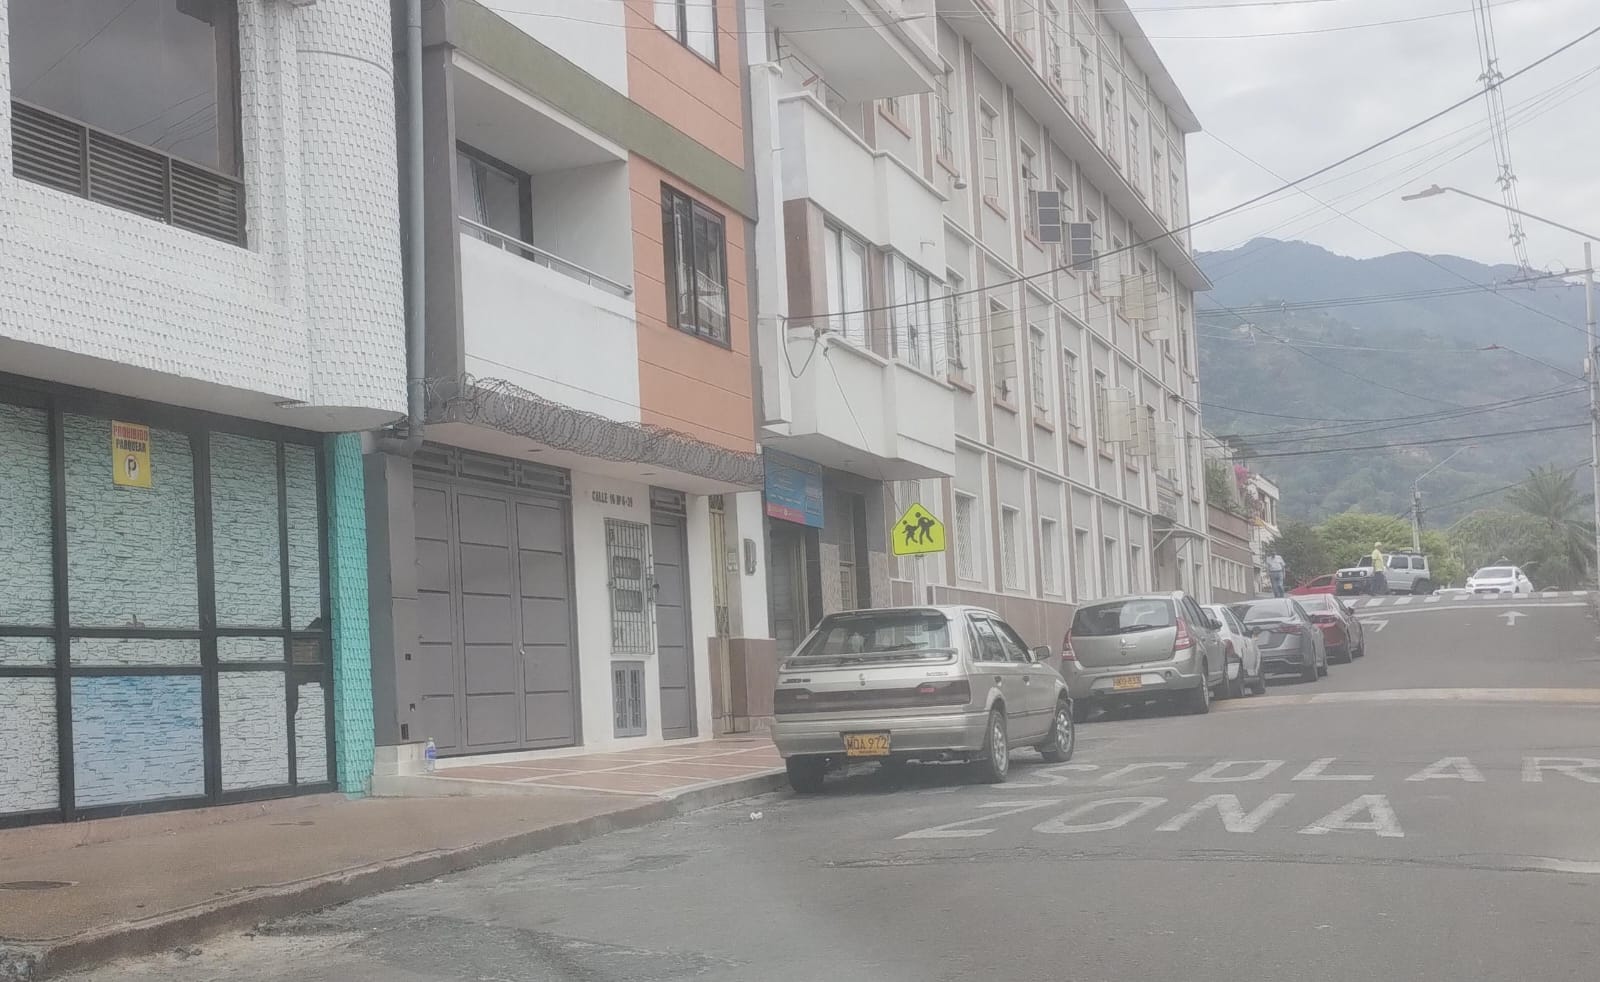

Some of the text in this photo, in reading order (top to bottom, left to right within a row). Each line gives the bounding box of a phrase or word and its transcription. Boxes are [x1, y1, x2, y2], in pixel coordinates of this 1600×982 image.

[113, 425, 148, 441] PROHIBIDO
[116, 438, 147, 453] PARQUEAR
[592, 490, 608, 503] CALLE
[868, 737, 888, 750] 972
[914, 755, 1600, 796] SCOLAR
[895, 793, 1405, 838] ZONA
